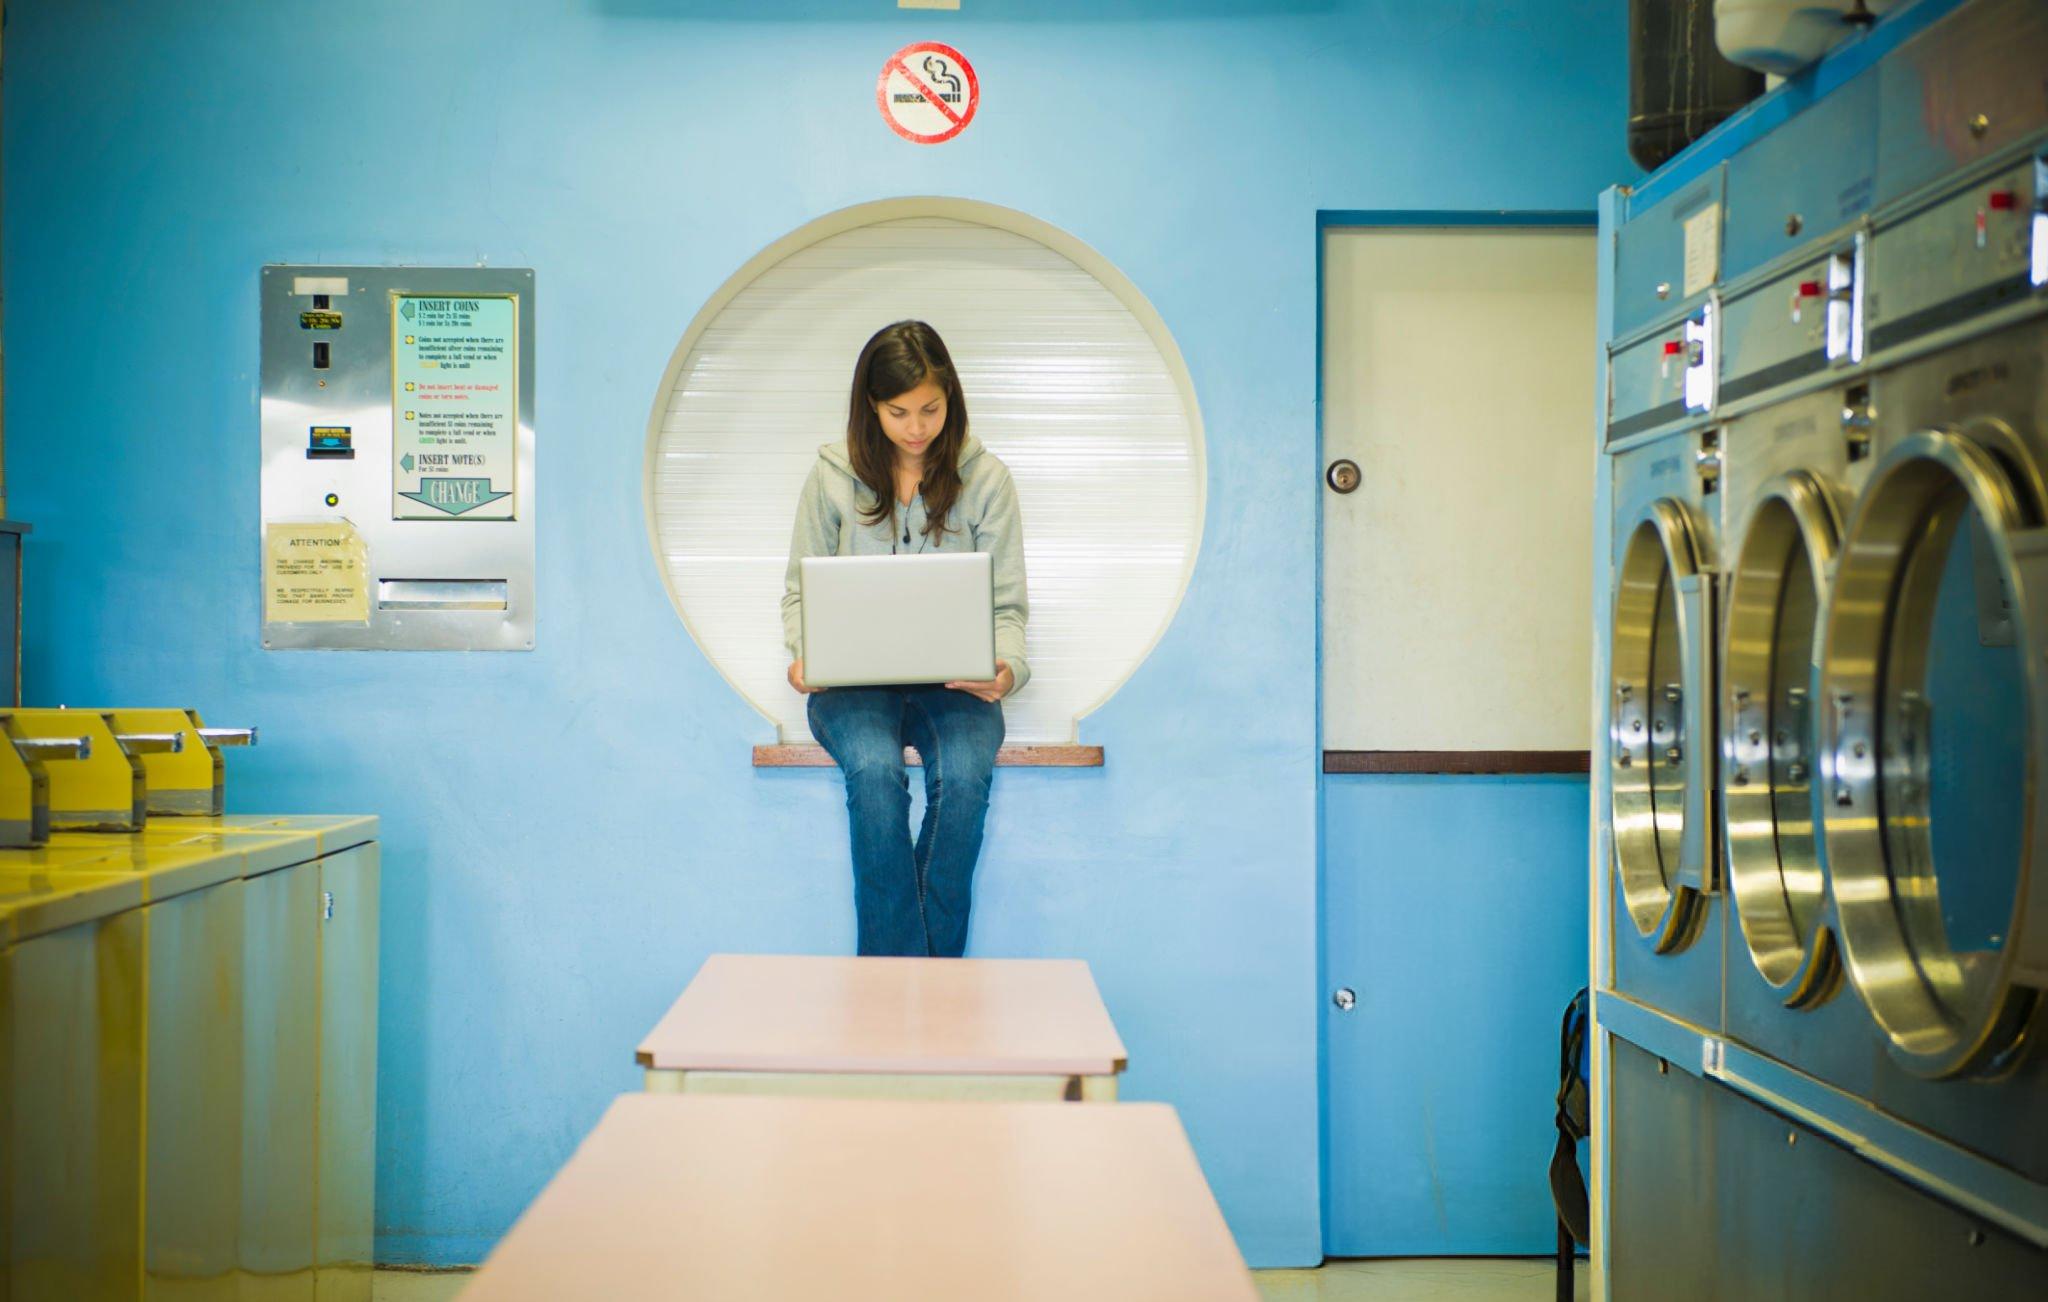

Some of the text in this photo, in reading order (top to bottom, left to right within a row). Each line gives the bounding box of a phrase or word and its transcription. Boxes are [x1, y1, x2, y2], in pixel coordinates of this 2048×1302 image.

[419, 300, 480, 312] INSERT COINS
[419, 454, 486, 467] INSERT NOTE(S)
[431, 480, 480, 504] CHANGE
